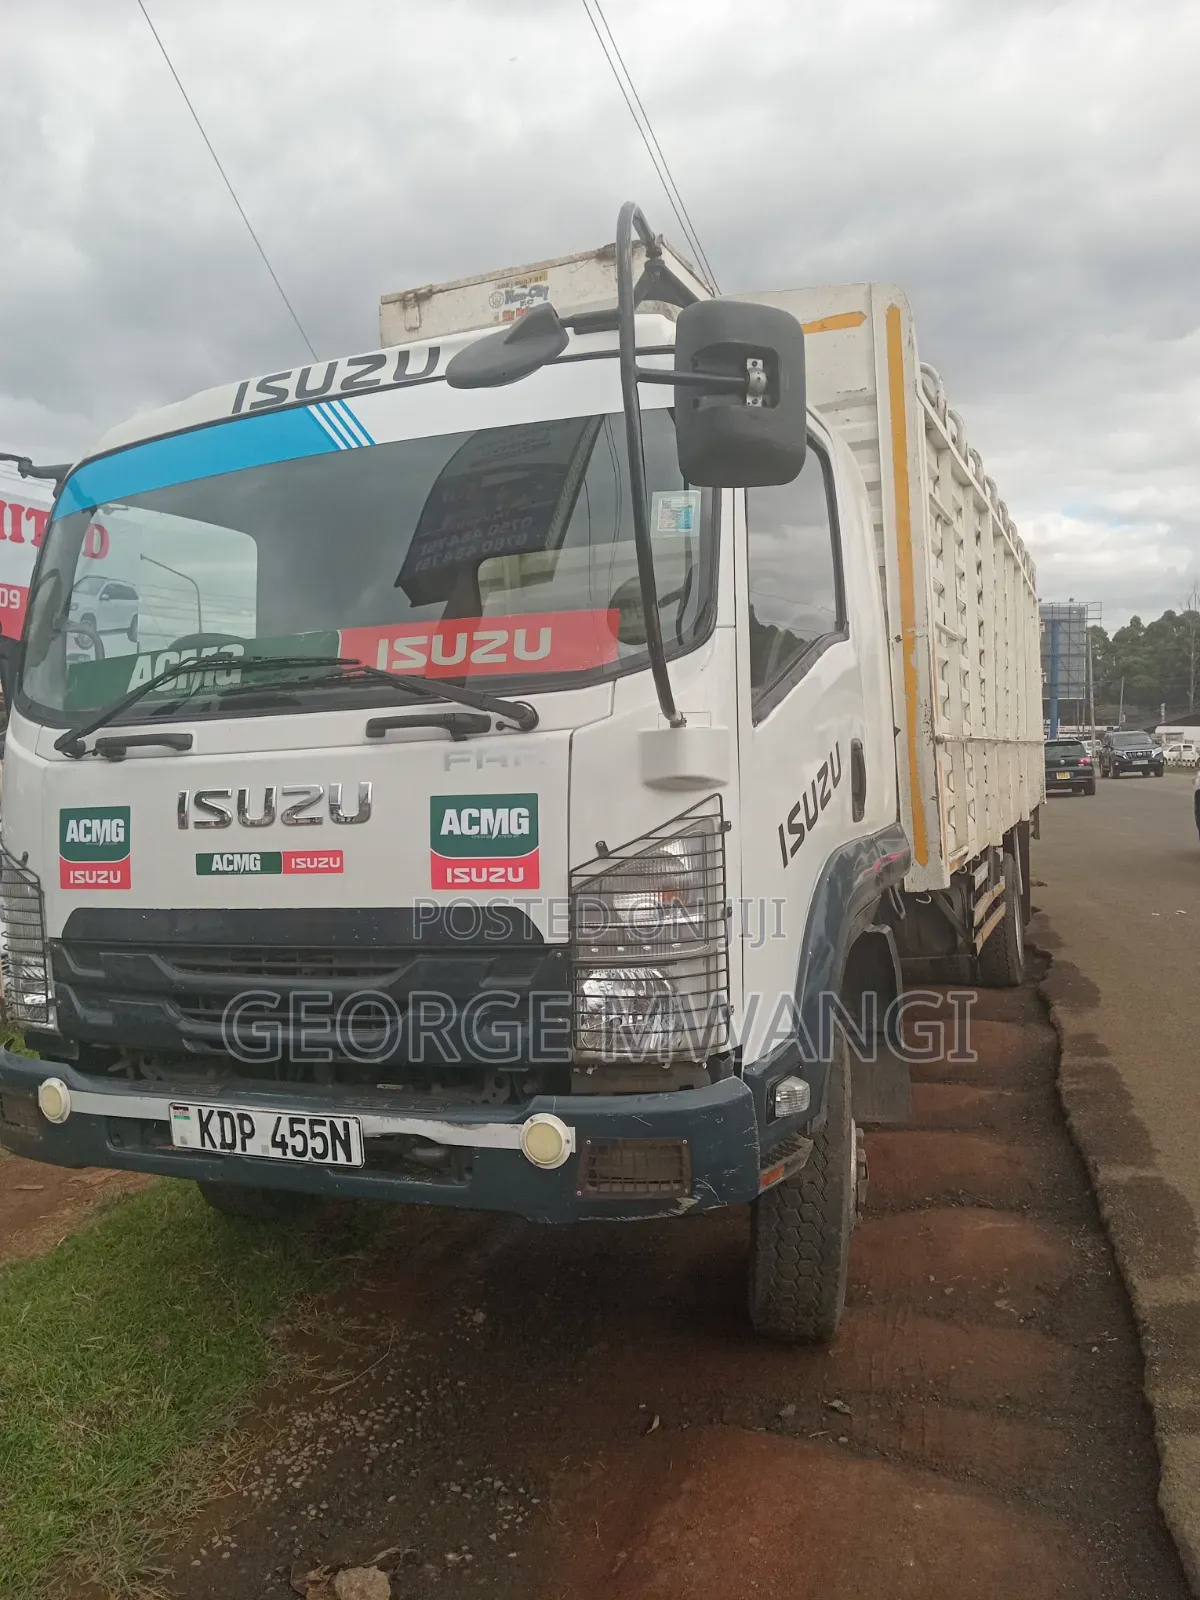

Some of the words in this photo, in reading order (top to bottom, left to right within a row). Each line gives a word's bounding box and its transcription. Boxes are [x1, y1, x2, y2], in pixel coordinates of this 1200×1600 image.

[231, 346, 441, 414] ISUZU
[376, 627, 552, 670] ISUZU
[126, 644, 245, 696] ACMG
[177, 781, 373, 830] ISUZU
[440, 807, 530, 840] ACMG
[778, 741, 842, 869] ISUZU
[65, 818, 125, 847] ACMG
[69, 870, 121, 884] ISUZU
[211, 853, 261, 874] ACMG
[291, 857, 341, 869] ISUZU
[446, 867, 525, 883] ISUZU
[198, 1108, 256, 1152] KDP
[271, 1116, 353, 1163] 455N
